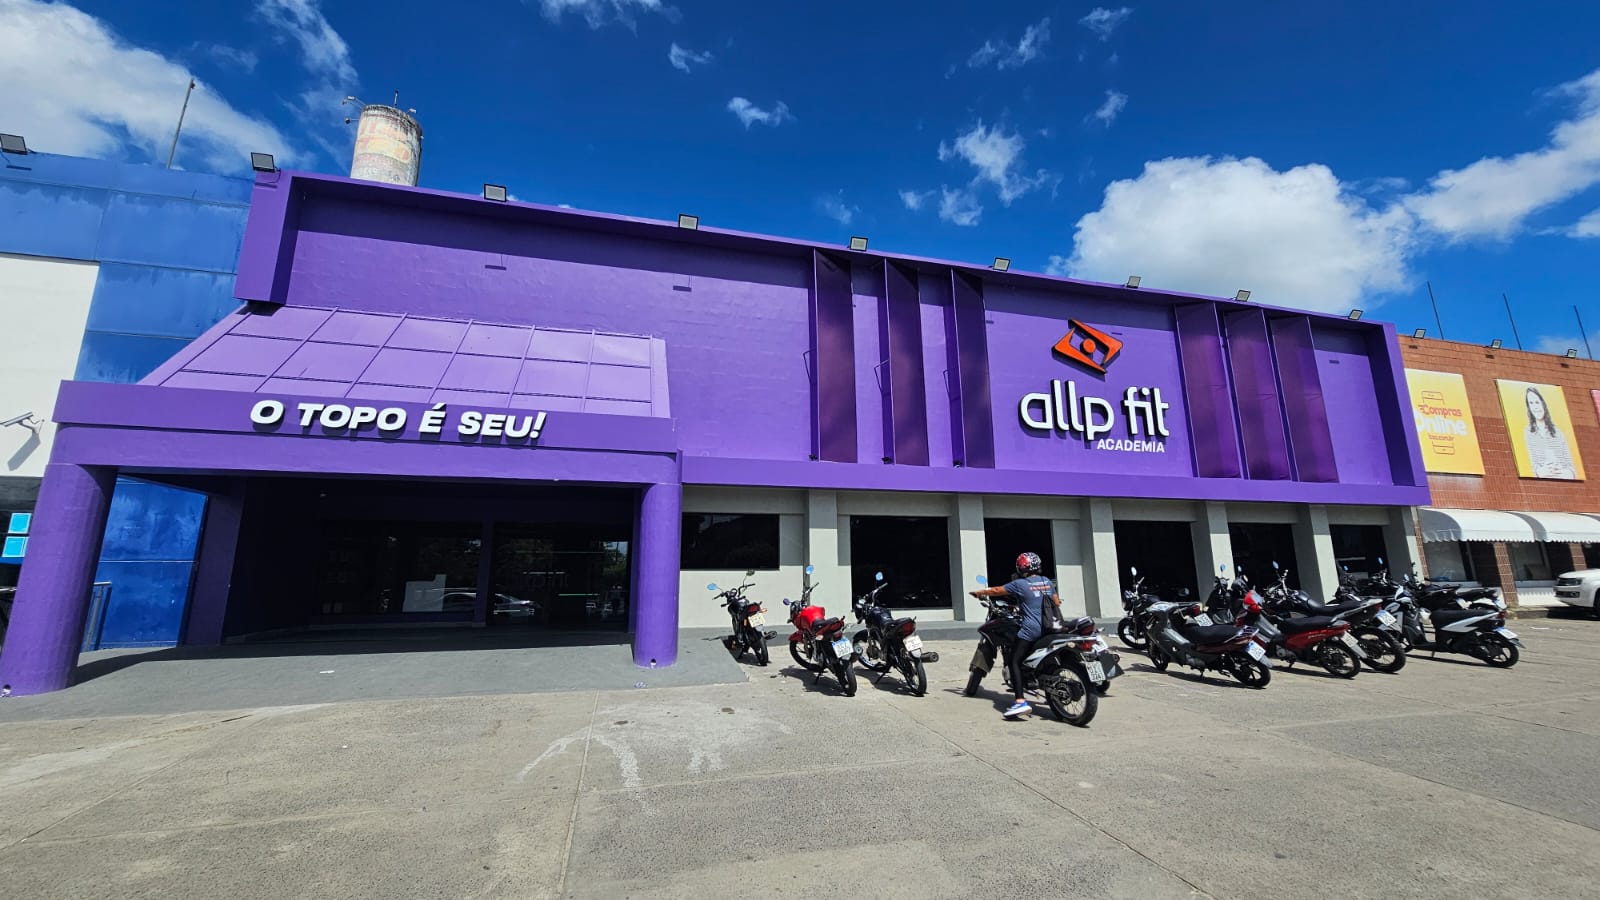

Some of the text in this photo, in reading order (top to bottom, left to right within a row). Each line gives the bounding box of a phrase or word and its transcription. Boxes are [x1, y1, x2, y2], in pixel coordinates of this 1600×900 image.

[250, 400, 547, 439] O TOPO É SEU!
[1020, 379, 1169, 440] allp fit
[1420, 404, 1463, 418] Compras
[1414, 412, 1469, 435] Online
[1097, 438, 1166, 453] ACADEMIA
